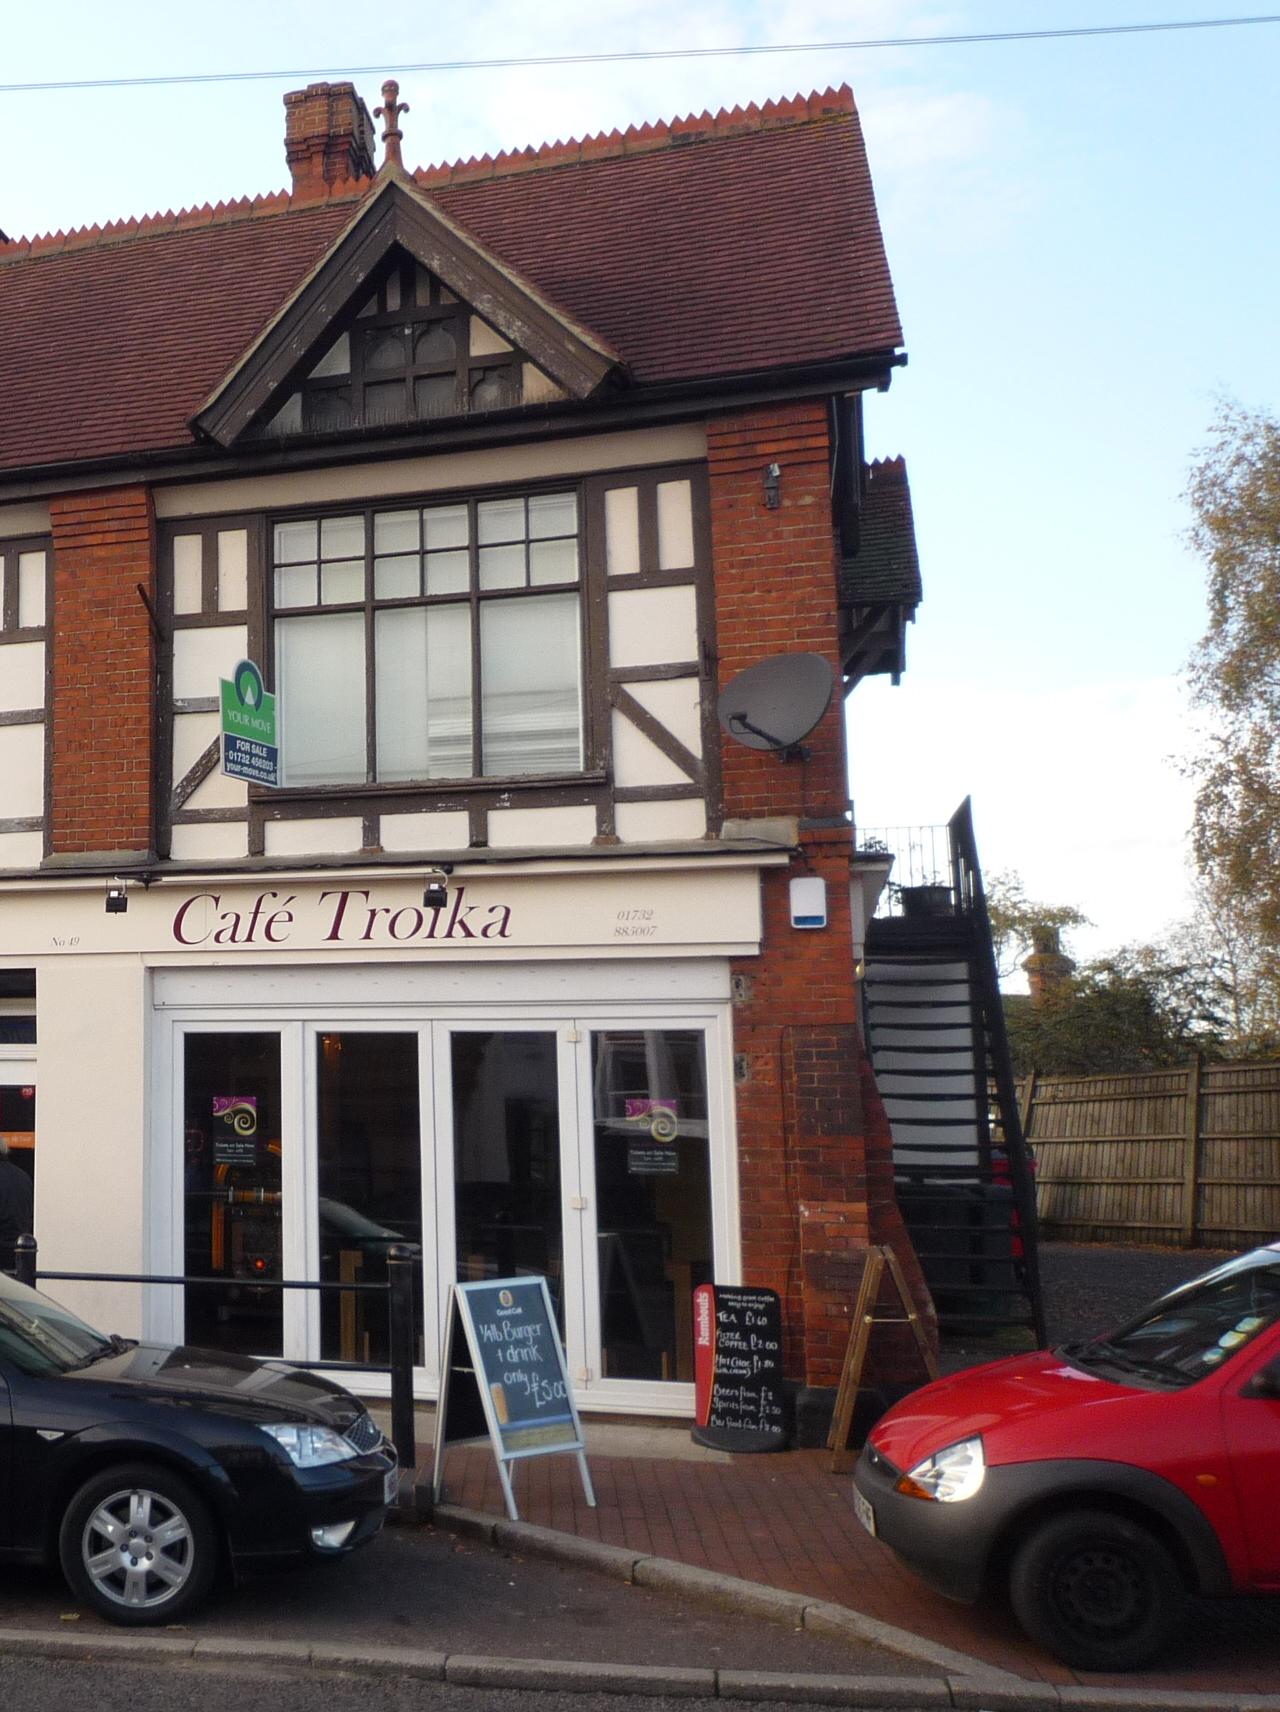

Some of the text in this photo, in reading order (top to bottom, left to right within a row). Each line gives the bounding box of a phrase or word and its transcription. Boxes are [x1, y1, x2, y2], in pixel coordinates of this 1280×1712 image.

[227, 709, 272, 734] YOUR MOVE
[236, 740, 267, 757] FOR SALE
[171, 886, 513, 946] Café Troika
[716, 1310, 737, 1324] TEA
[503, 1320, 544, 1345] Burger
[506, 1345, 544, 1363] drink
[503, 1369, 529, 1395] only
